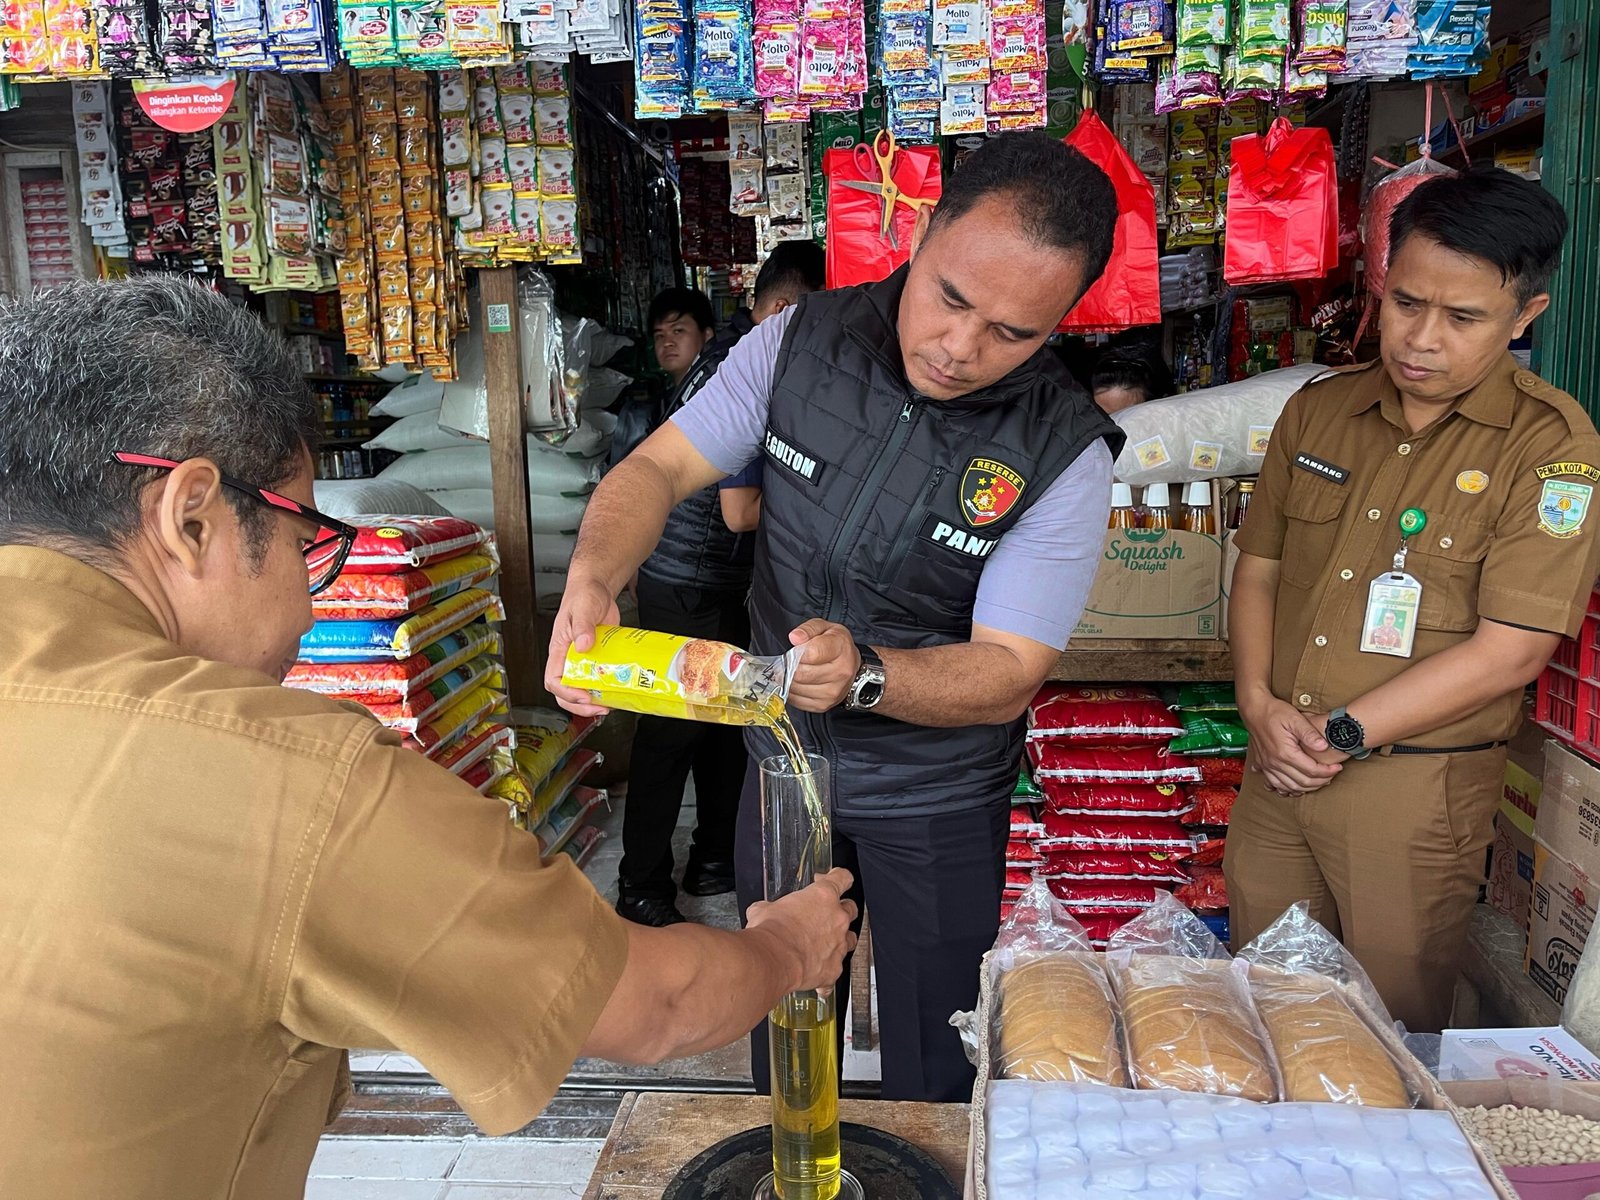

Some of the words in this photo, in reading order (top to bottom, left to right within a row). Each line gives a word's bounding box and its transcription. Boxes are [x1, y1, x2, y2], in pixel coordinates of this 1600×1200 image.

[946, 9, 970, 18] Molto
[170, 22, 202, 30] sunilk
[704, 30, 733, 40] Molto
[761, 43, 790, 54] Molto
[1004, 44, 1027, 54] Molto
[956, 59, 980, 67] Molto
[149, 95, 191, 106] Dinginkan
[193, 93, 224, 104] Kepala
[150, 107, 187, 117] Hilangkan
[188, 105, 223, 114] Ketombe
[952, 110, 975, 118] Molto
[834, 139, 853, 148] MILO
[977, 460, 1020, 486] RESERSE
[1298, 456, 1342, 480] BAMBANG
[1538, 464, 1563, 477] PEMDA
[1564, 464, 1582, 473] KOTA
[1104, 540, 1184, 568] Squash
[1130, 561, 1167, 574] Delight
